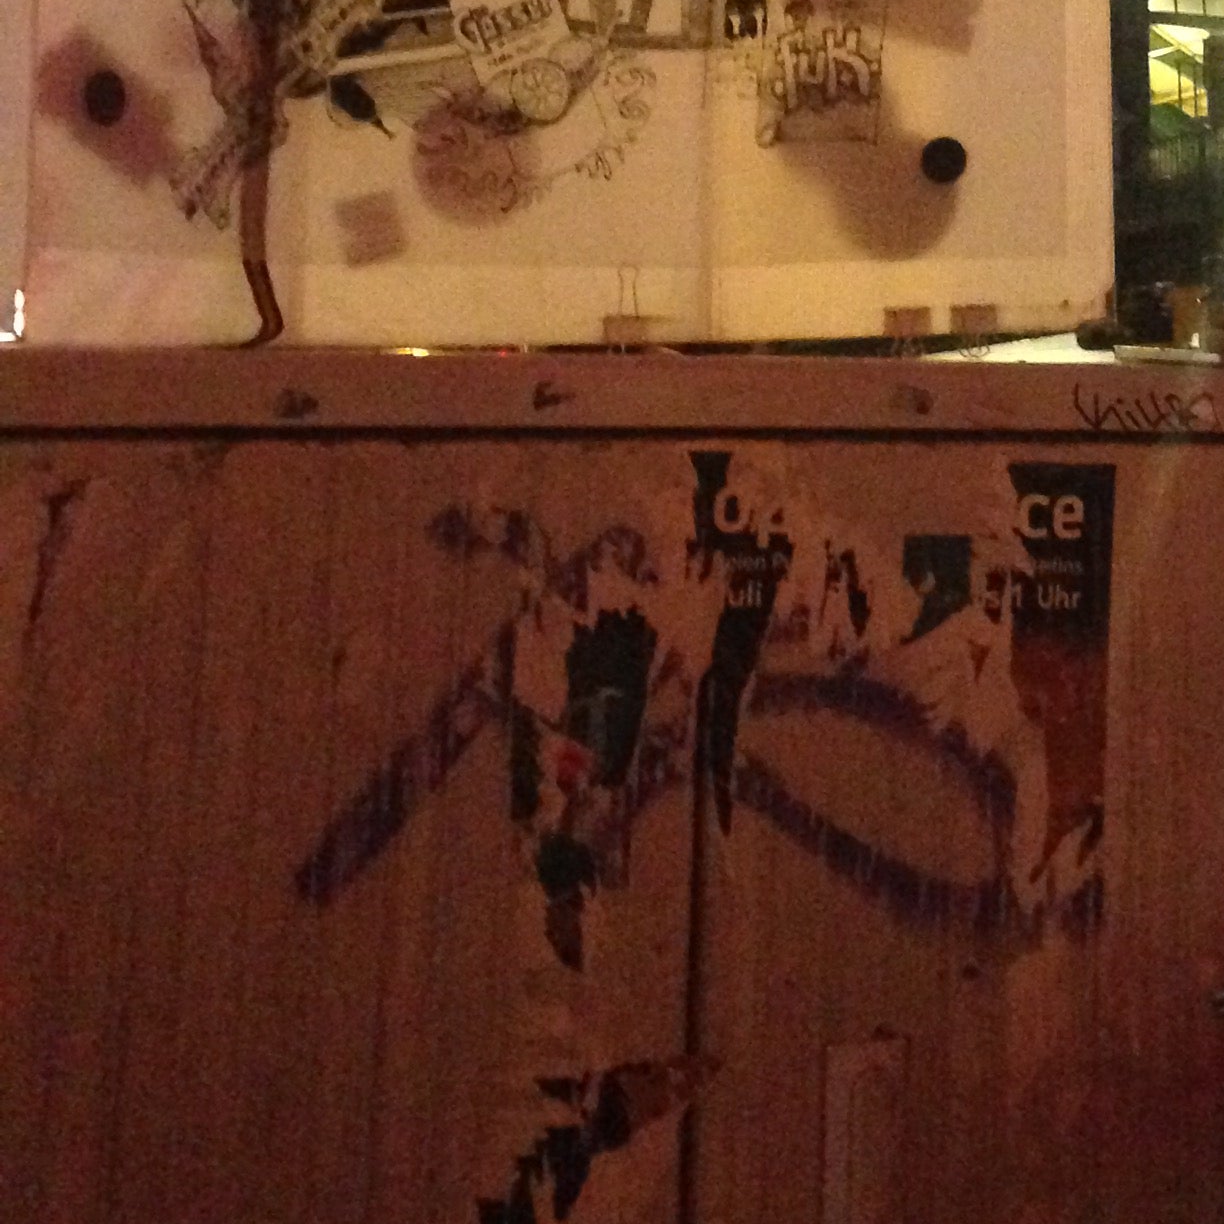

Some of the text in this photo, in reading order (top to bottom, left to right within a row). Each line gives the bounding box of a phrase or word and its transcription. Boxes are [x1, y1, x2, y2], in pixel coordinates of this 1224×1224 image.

[1018, 493, 1085, 539] ce
[727, 579, 763, 608] uli
[1036, 583, 1083, 611] Uhr
